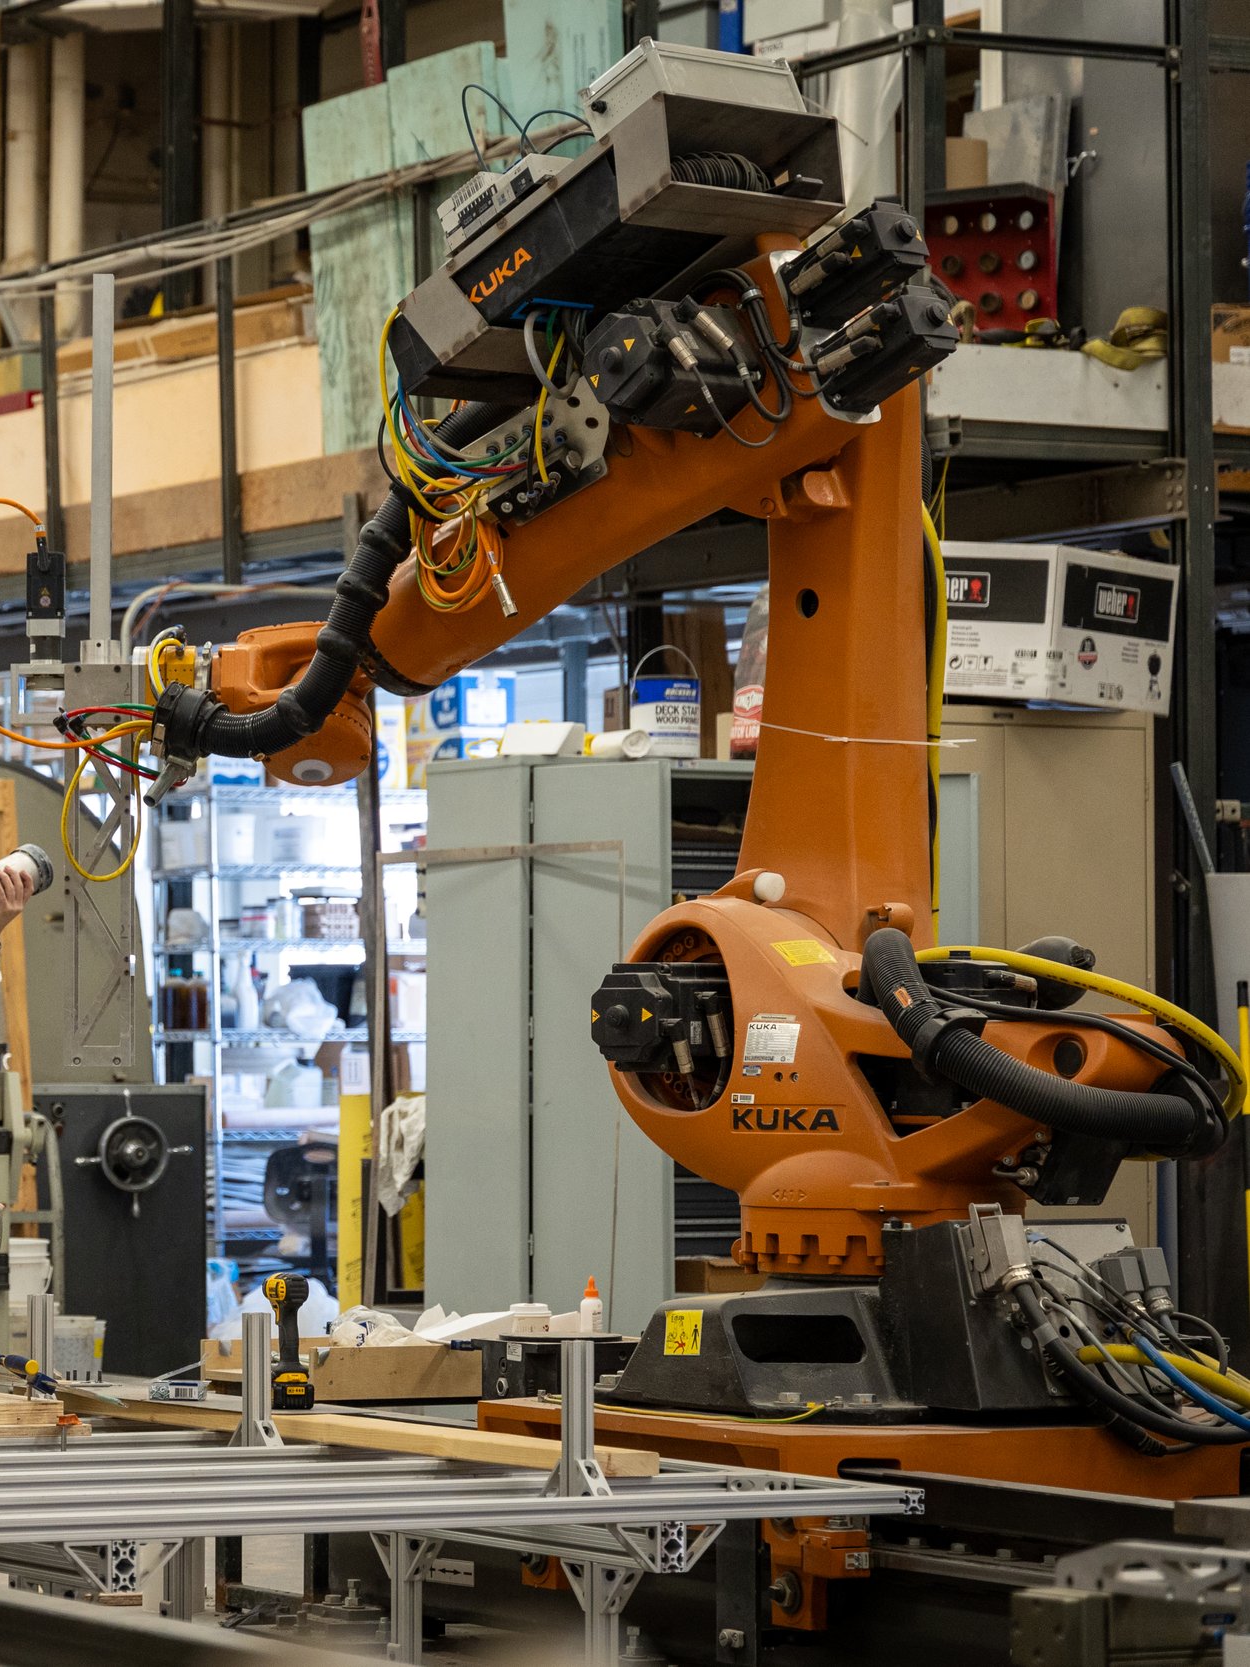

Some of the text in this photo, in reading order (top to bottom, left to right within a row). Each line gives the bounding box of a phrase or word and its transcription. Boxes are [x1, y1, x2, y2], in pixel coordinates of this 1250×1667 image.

[469, 247, 533, 303] KUKA
[1098, 586, 1128, 616] weber
[655, 705, 680, 715] DECK
[656, 716, 680, 724] WOOD
[733, 1108, 839, 1131] KUKA
